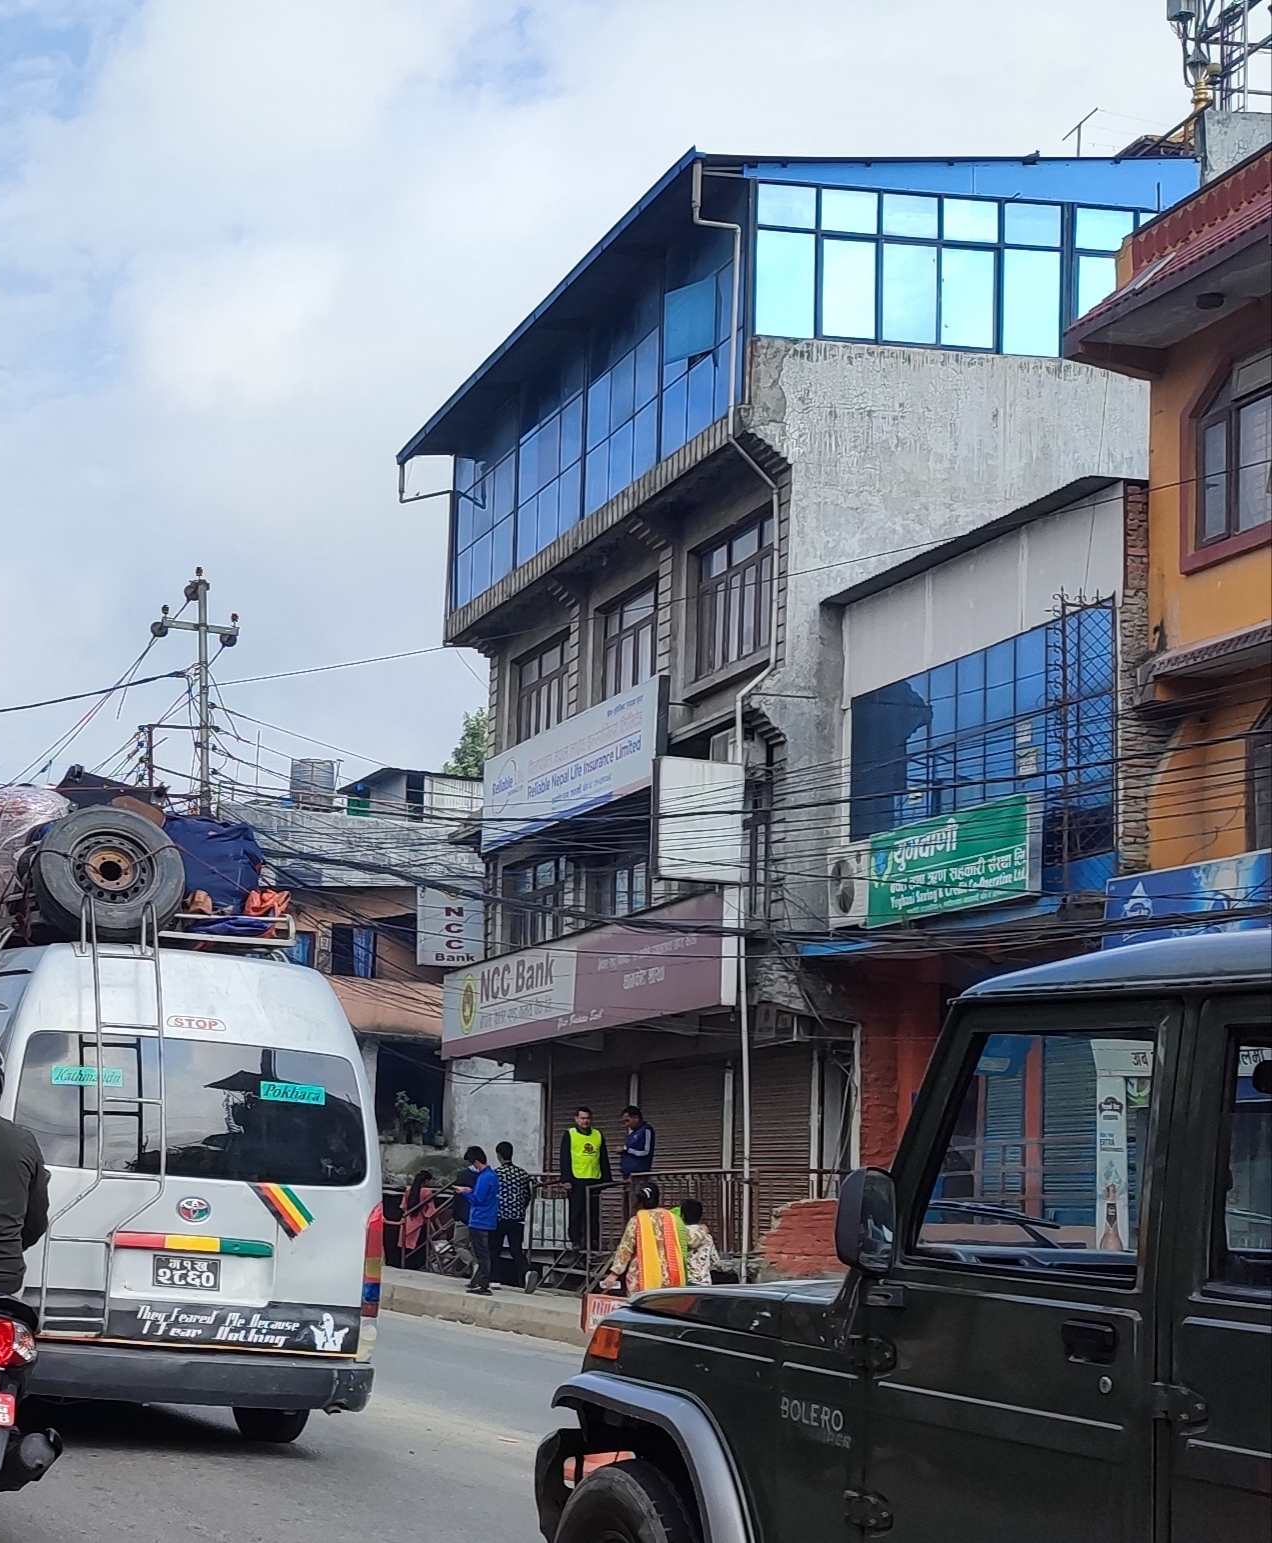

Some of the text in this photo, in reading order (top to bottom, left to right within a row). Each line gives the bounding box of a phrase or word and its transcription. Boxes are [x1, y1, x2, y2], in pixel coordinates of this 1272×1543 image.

[527, 778, 550, 799] Reliable
[551, 766, 569, 789] Nepal
[570, 763, 582, 781] Life
[583, 751, 614, 775] Insurance
[615, 735, 642, 760] Limited
[444, 906, 465, 950] NCC
[435, 952, 476, 962] Bank
[480, 963, 511, 1003] NCC
[515, 952, 555, 994] Bank
[174, 1017, 219, 1030] STOP
[265, 1083, 321, 1102] Pokhara
[158, 1269, 215, 1288] २८६०
[137, 1305, 301, 1331] They Feared Me Because
[153, 1322, 203, 1338] Fear
[211, 1325, 291, 1348] Nothing
[780, 1396, 844, 1432] BOLERO
